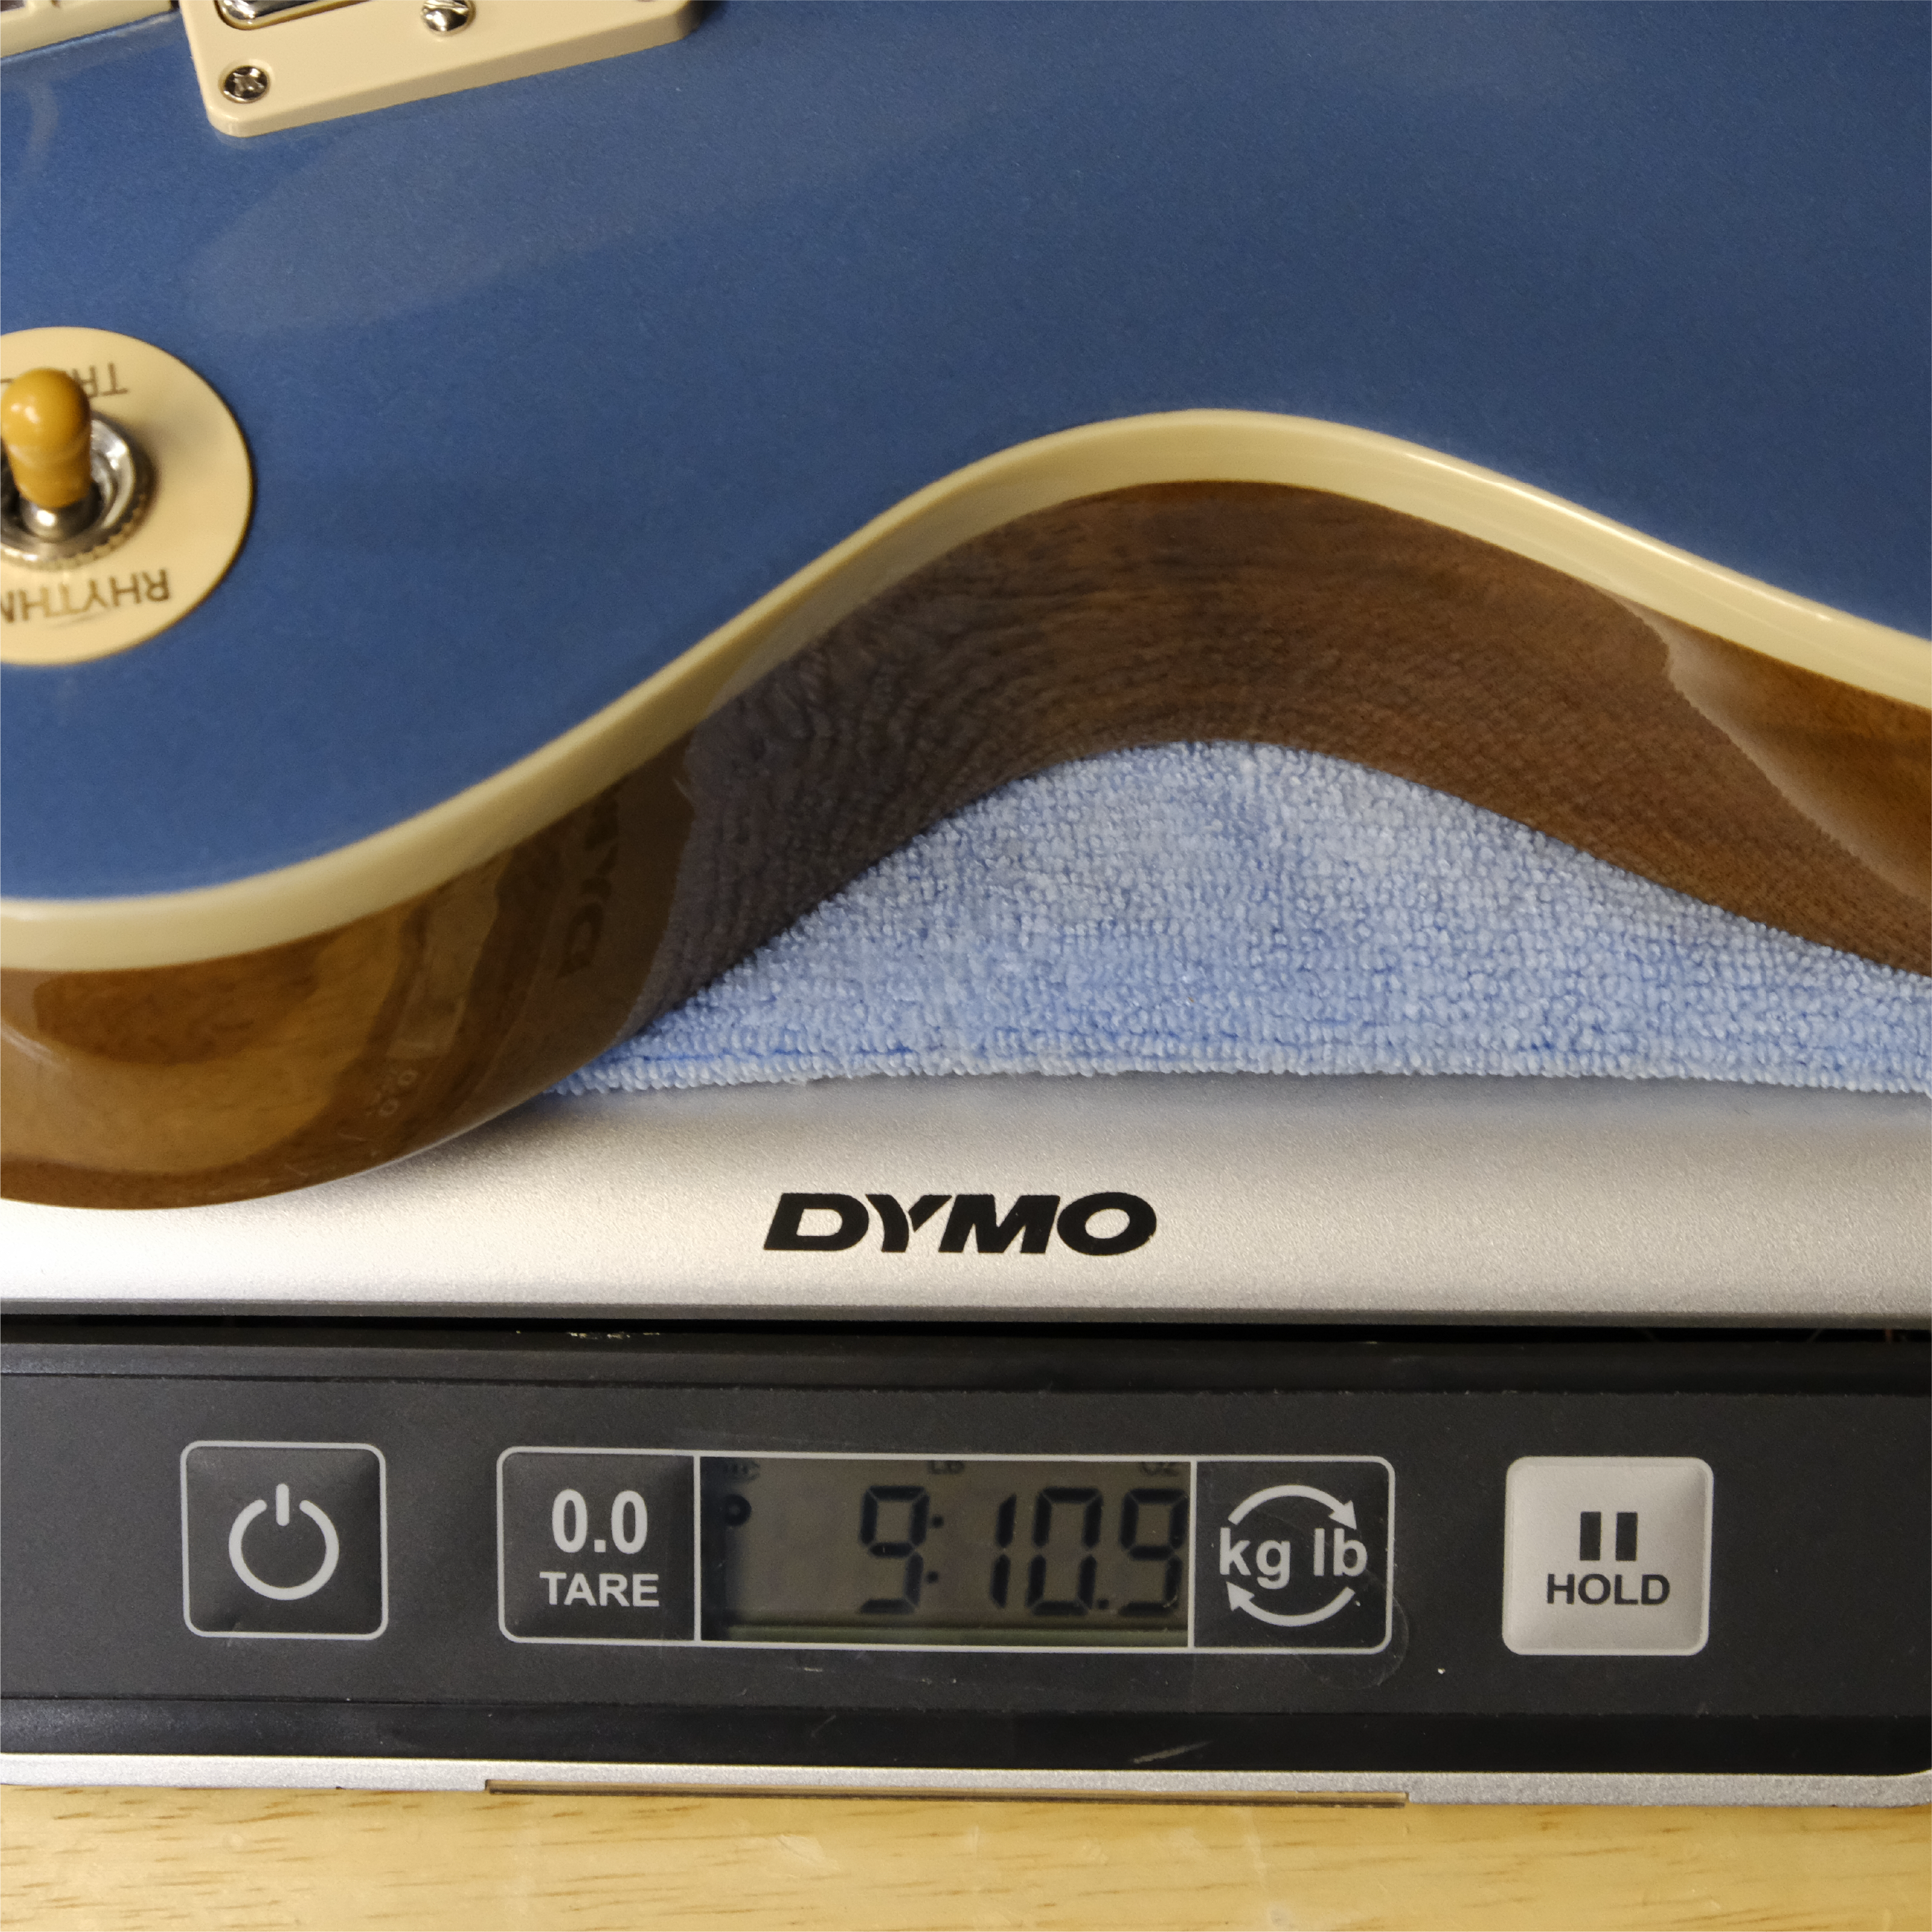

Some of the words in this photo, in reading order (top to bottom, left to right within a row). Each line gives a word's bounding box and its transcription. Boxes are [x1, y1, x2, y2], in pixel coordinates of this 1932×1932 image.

[764, 1191, 1157, 1256] DYMO
[552, 1488, 648, 1555] 0.0
[539, 1571, 660, 1607] TARE
[1219, 1527, 1290, 1590] kg
[1313, 1528, 1368, 1577] lb
[1547, 1573, 1670, 1605] HOLD
